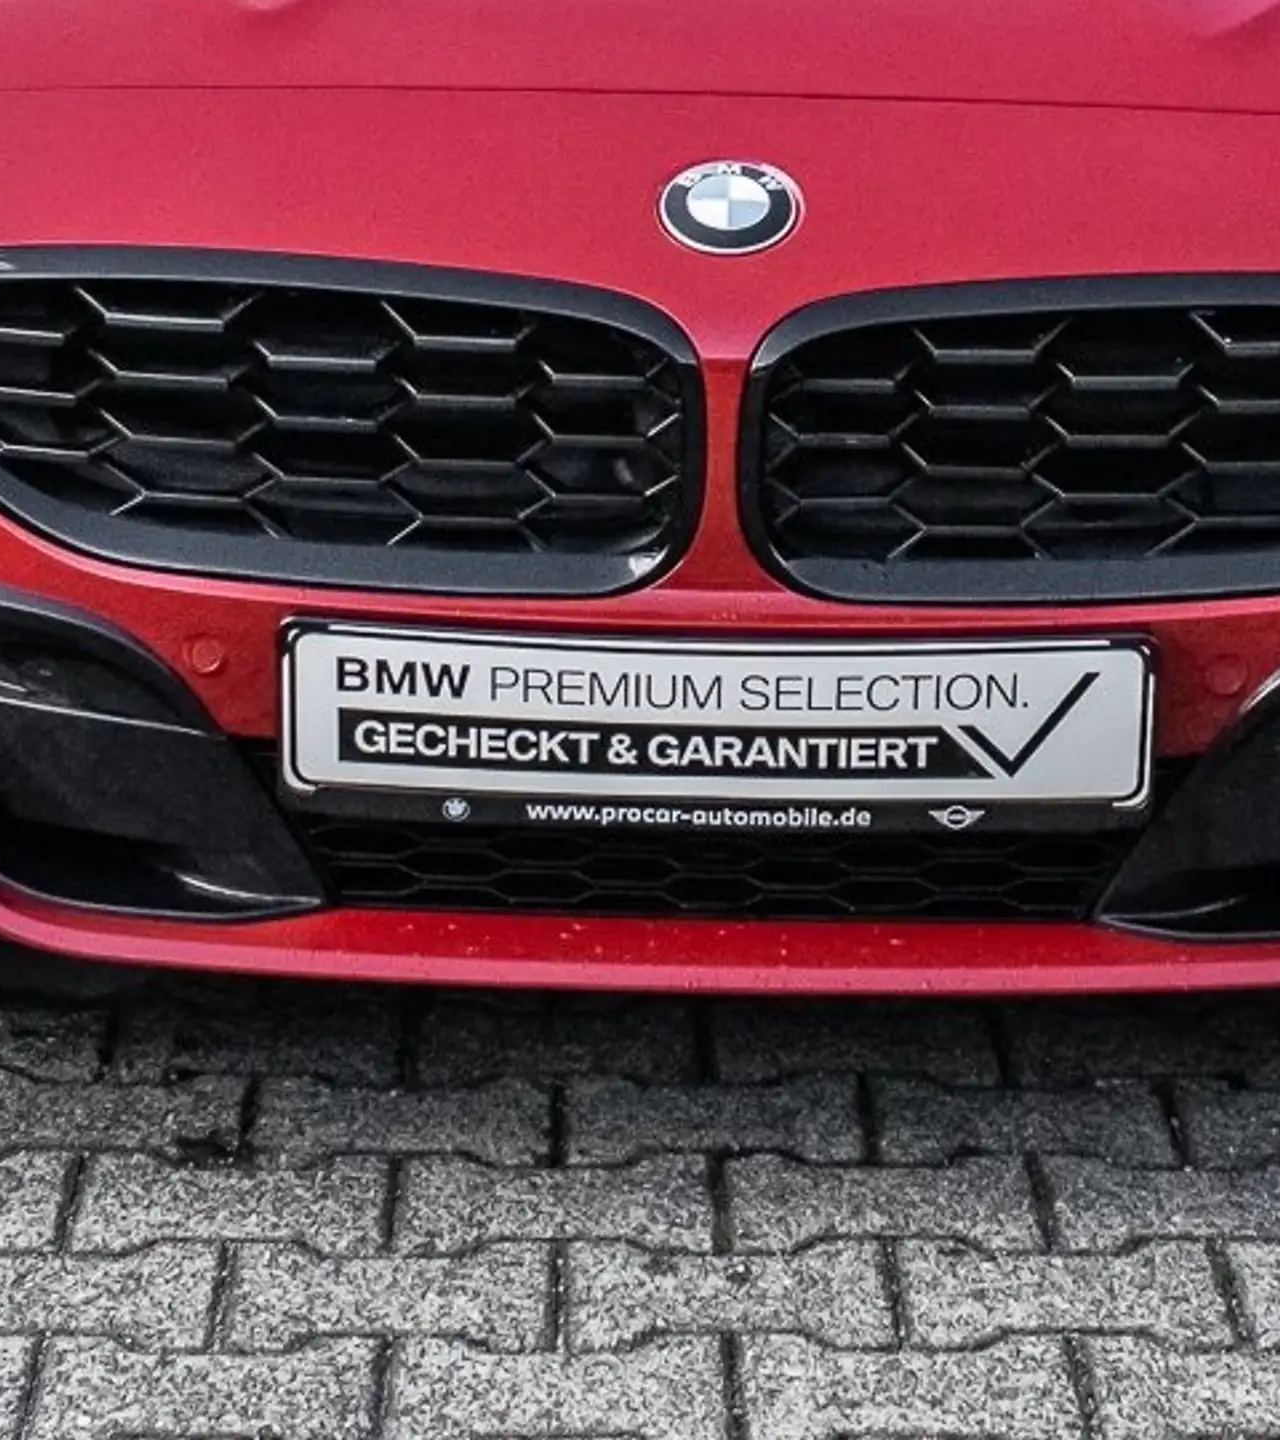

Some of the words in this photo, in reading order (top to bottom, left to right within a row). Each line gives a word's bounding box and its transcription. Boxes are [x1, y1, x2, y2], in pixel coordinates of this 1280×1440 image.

[336, 656, 470, 699] BMW
[490, 666, 723, 711] PREMIUM
[739, 672, 1029, 712] SELECTION.
[354, 719, 600, 765] GECHECKT
[607, 733, 639, 766] &
[647, 733, 939, 770] GARANTIERT
[525, 803, 872, 828] www.procar-automobile.de
